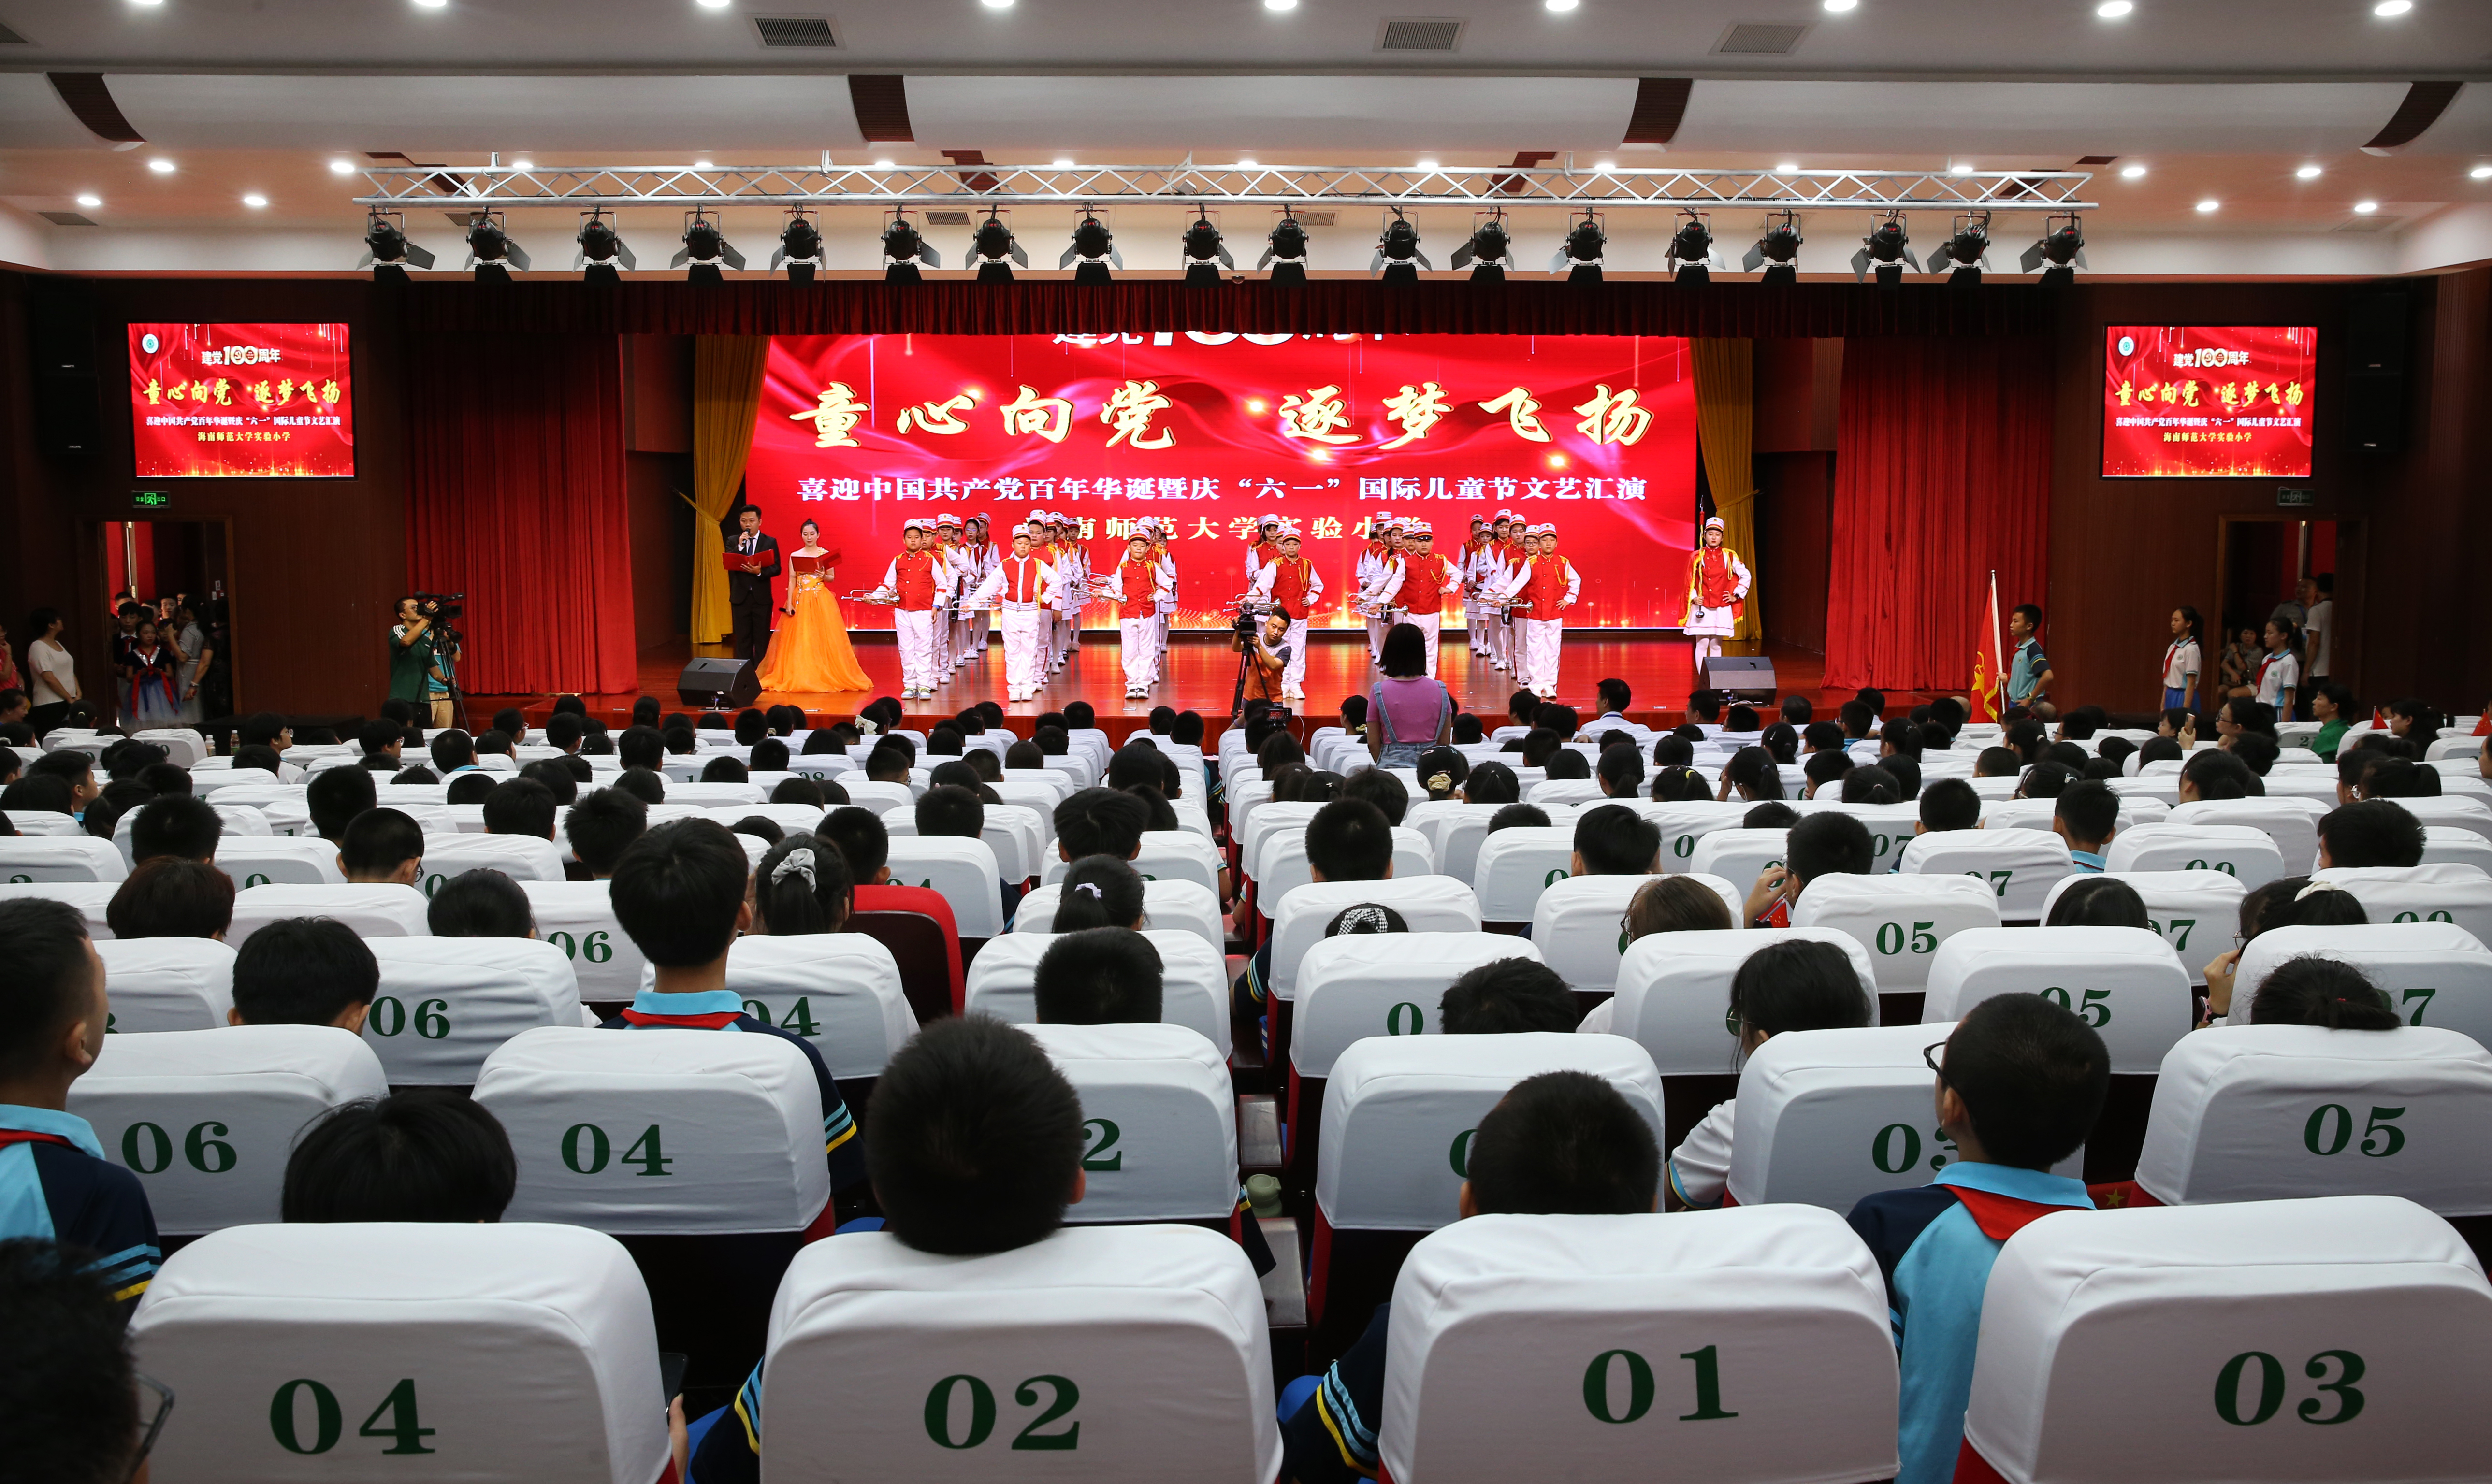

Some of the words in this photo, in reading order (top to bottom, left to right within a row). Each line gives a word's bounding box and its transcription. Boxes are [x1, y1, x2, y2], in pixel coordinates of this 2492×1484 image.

[201, 346, 281, 365] 建党100周年
[2173, 348, 2249, 368] 建党100周年
[143, 379, 232, 406] 童心向党
[254, 378, 341, 406] 逐梦飞扬
[790, 380, 1177, 450] 童心向党
[1278, 382, 1654, 450] 逐梦飞扬
[2115, 380, 2199, 407] 童心向党
[2221, 381, 2304, 407] 逐梦飞扬
[198, 432, 290, 442] 海南师范大学实验小学
[2163, 432, 2252, 442] 海南师范大学实验小学
[1876, 921, 1938, 955] 05
[368, 996, 450, 1039] 06
[121, 1121, 237, 1174] 06
[561, 1123, 673, 1177] 04
[2304, 1104, 2406, 1158] 05
[1583, 1345, 1739, 1425] 01
[2215, 1350, 2366, 1426] 03
[270, 1379, 436, 1455] 04
[924, 1375, 1080, 1451] 02
